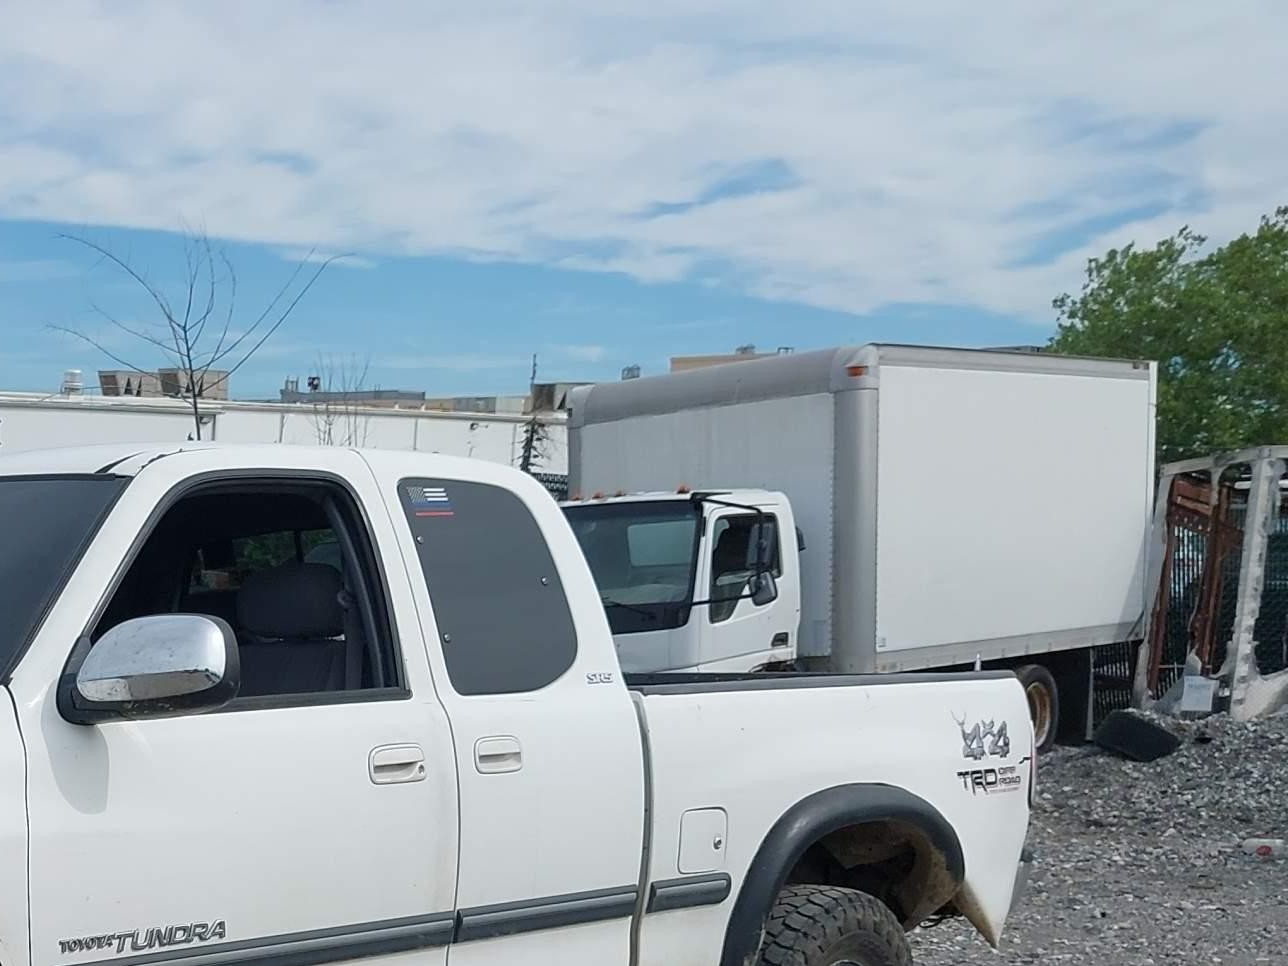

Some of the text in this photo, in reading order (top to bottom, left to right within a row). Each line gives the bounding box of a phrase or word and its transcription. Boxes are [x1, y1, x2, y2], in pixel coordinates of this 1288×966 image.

[957, 768, 998, 795] TRD
[998, 775, 1021, 785] ROAD
[58, 919, 227, 954] TOYOTA TUNDRA
